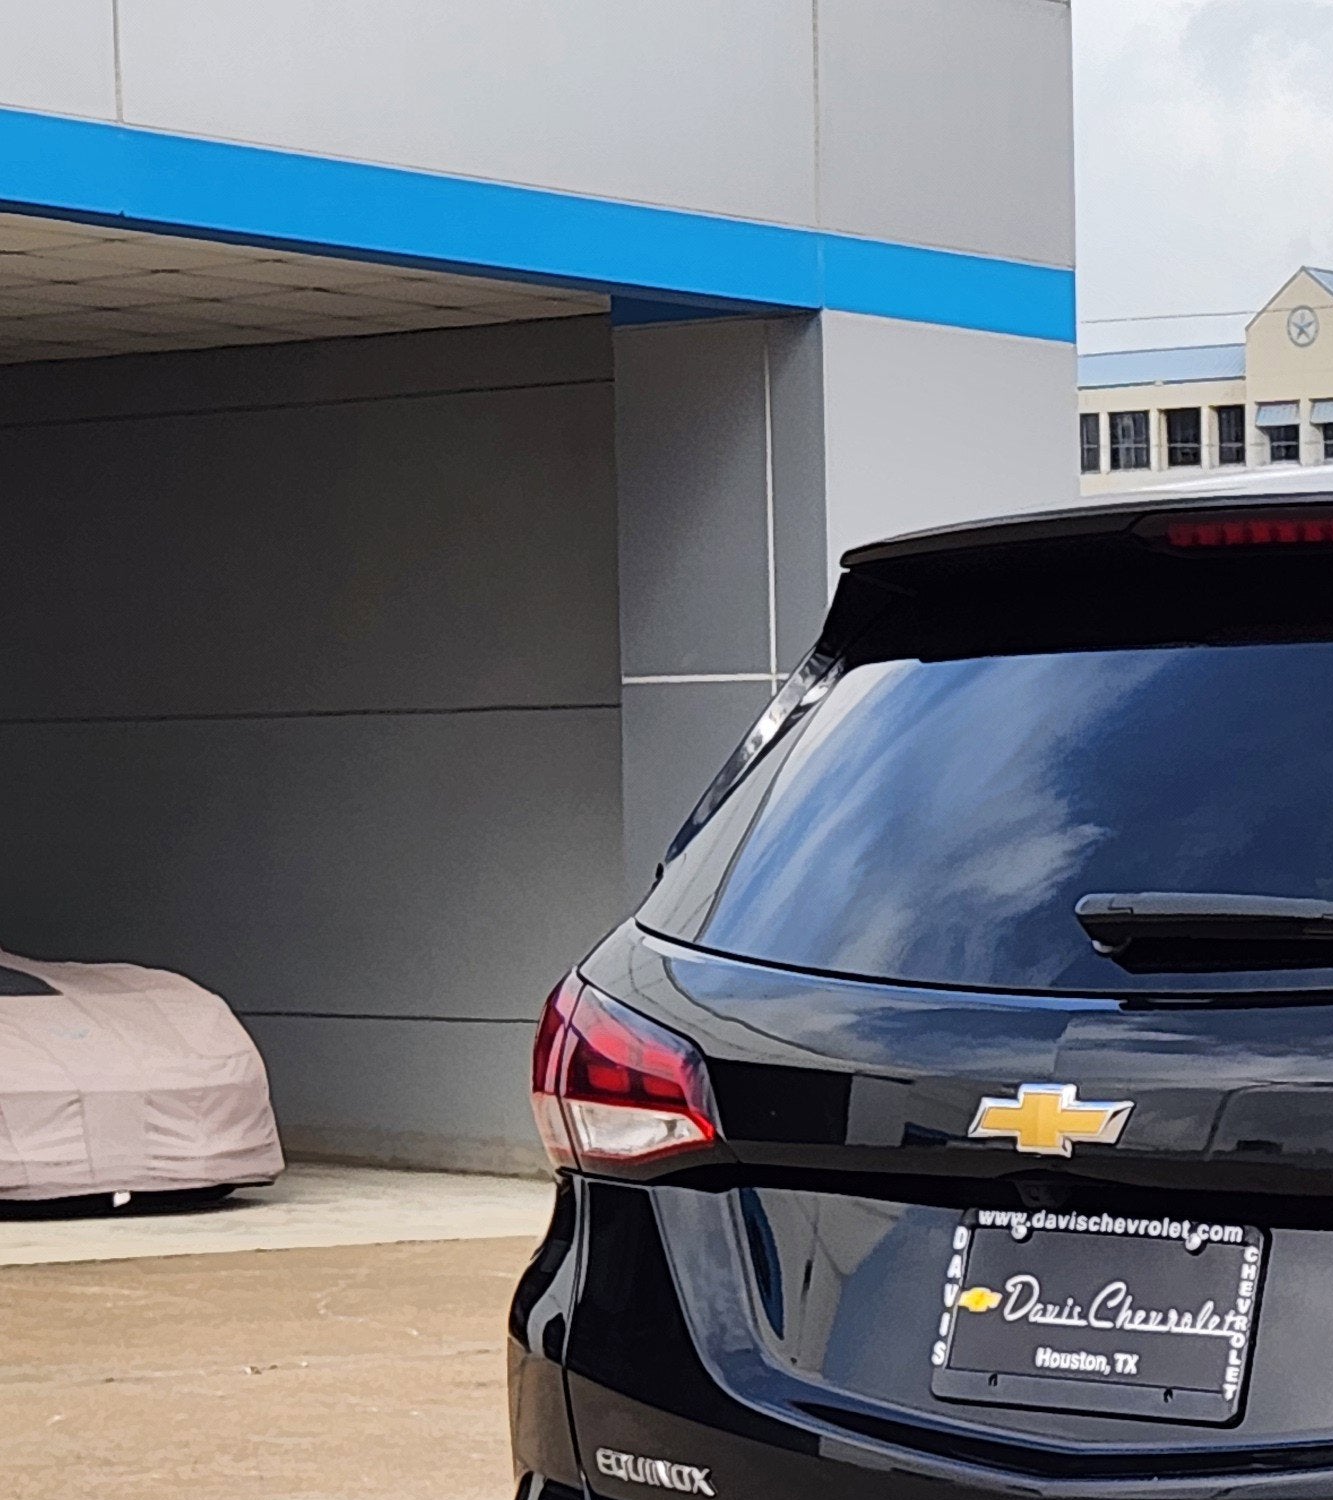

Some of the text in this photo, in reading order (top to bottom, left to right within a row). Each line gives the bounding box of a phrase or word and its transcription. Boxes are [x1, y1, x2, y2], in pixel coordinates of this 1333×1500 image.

[978, 1209, 1243, 1242] www.davischevroletcom
[1003, 1274, 1236, 1337] Davis Chevrolet
[1035, 1347, 1139, 1375] Houston, TX
[596, 1448, 716, 1497] EQUINOX
